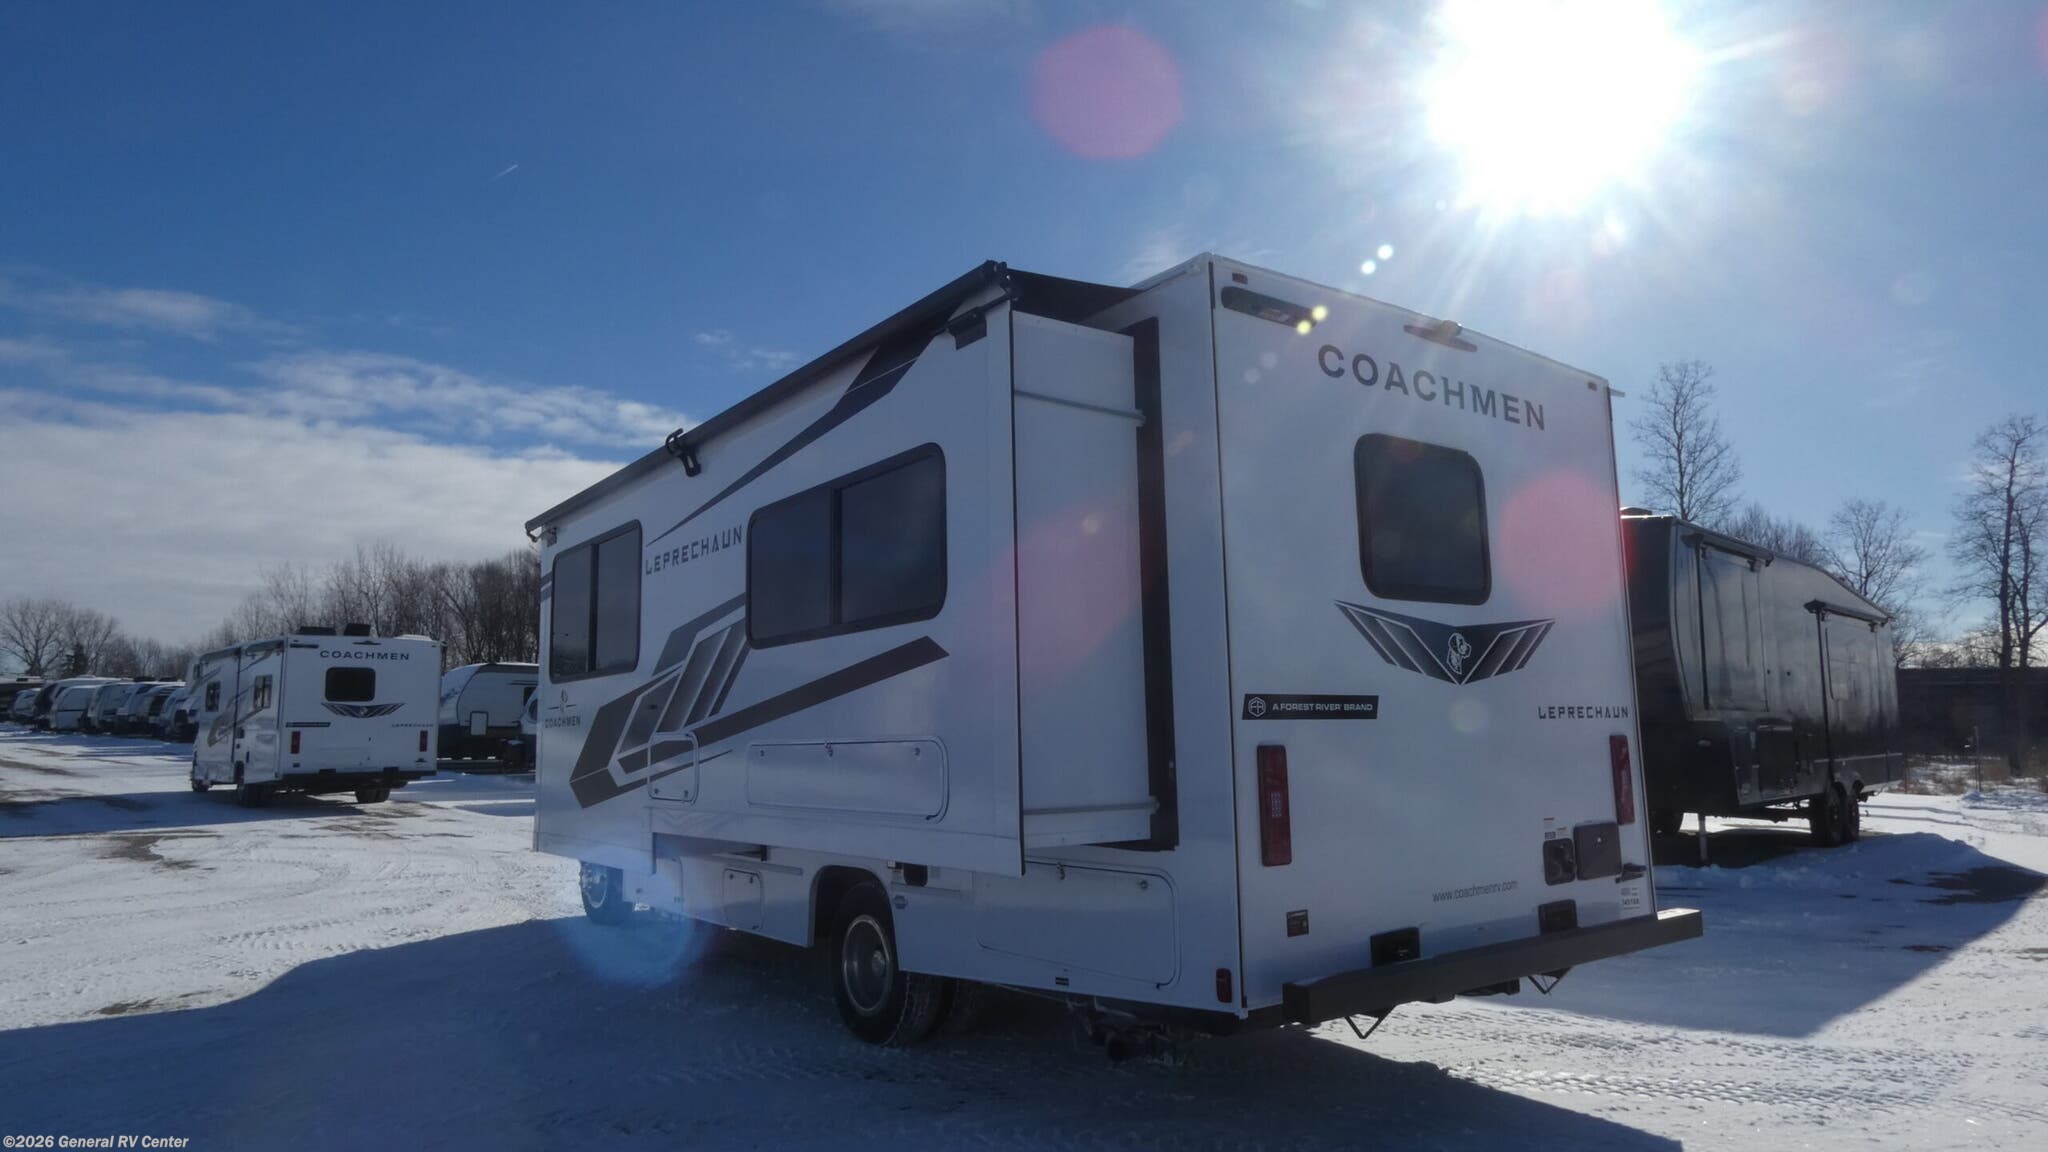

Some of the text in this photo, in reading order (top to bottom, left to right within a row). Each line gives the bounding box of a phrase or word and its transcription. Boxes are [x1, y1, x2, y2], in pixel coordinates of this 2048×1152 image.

[1317, 344, 1546, 431] COACHMEN
[645, 524, 743, 576] LEPRECHAUN
[319, 650, 410, 661] COACHMEN
[1271, 703, 1279, 711] A
[1280, 703, 1314, 711] FOREST
[1343, 703, 1373, 711] BRAND
[1537, 706, 1629, 719] LEPRECHAUN
[544, 715, 581, 728] COACHMEN
[1432, 880, 1518, 902] www.coachmenrv.com
